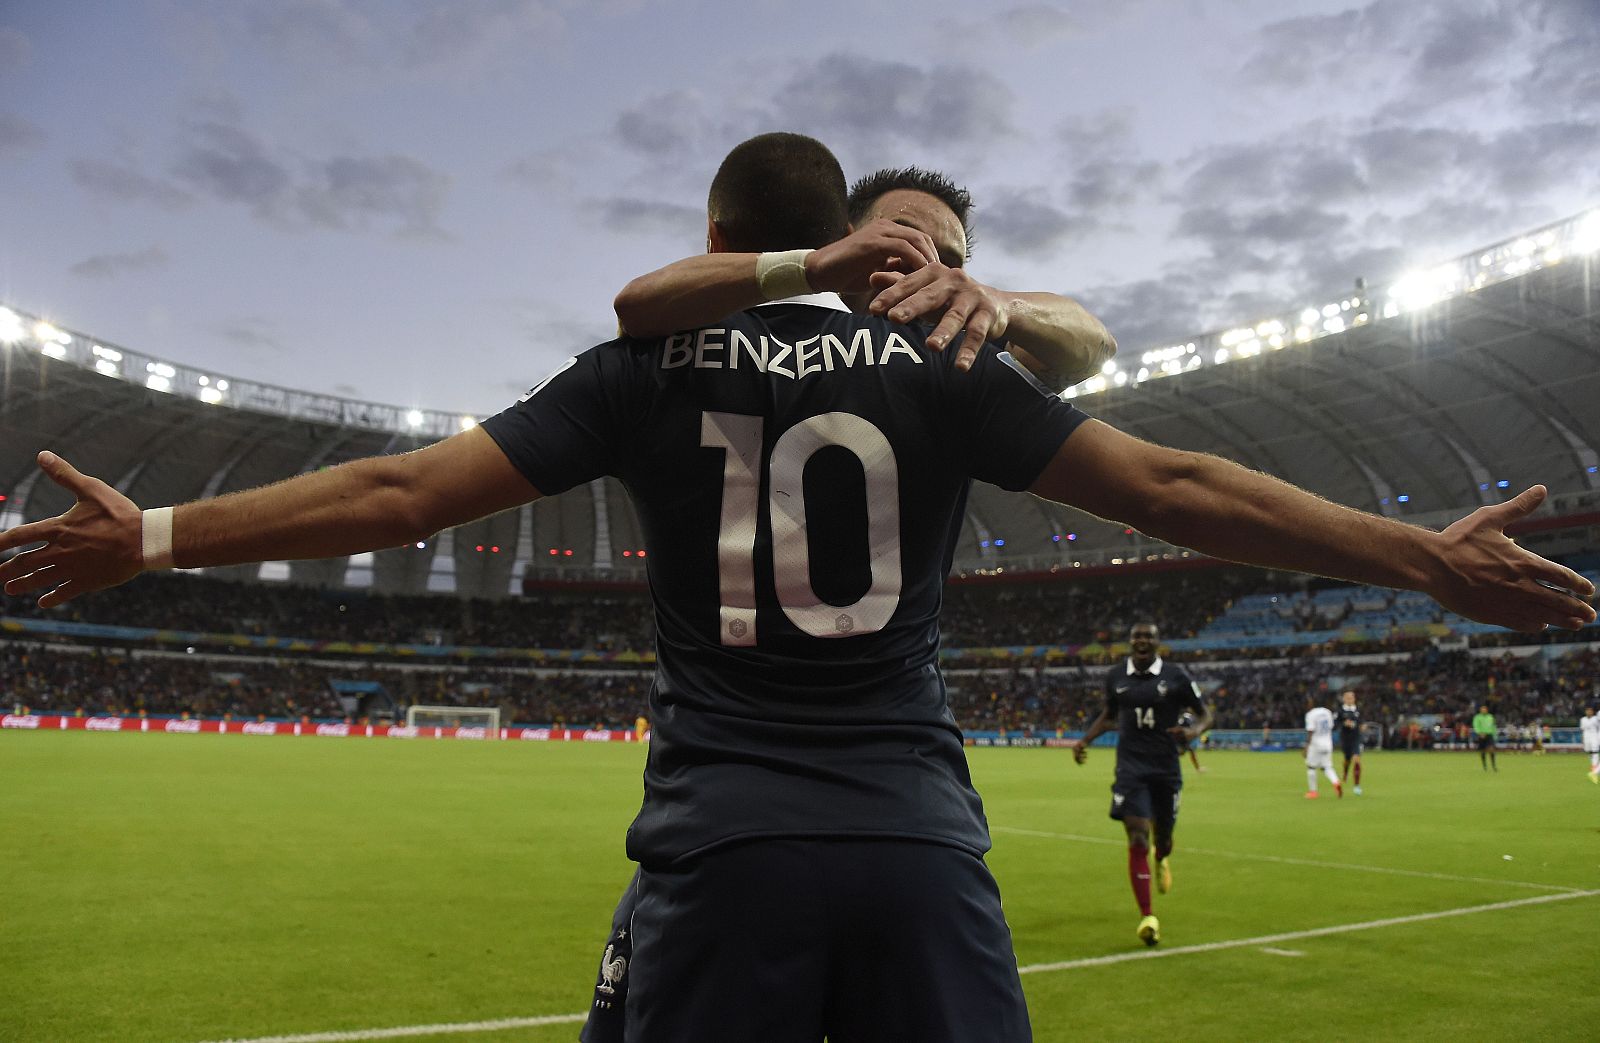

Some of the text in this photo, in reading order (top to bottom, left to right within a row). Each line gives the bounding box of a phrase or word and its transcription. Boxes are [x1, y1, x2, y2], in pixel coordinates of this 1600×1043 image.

[661, 328, 923, 380] BENZEMA
[700, 411, 902, 646] 10
[1134, 707, 1155, 729] 14
